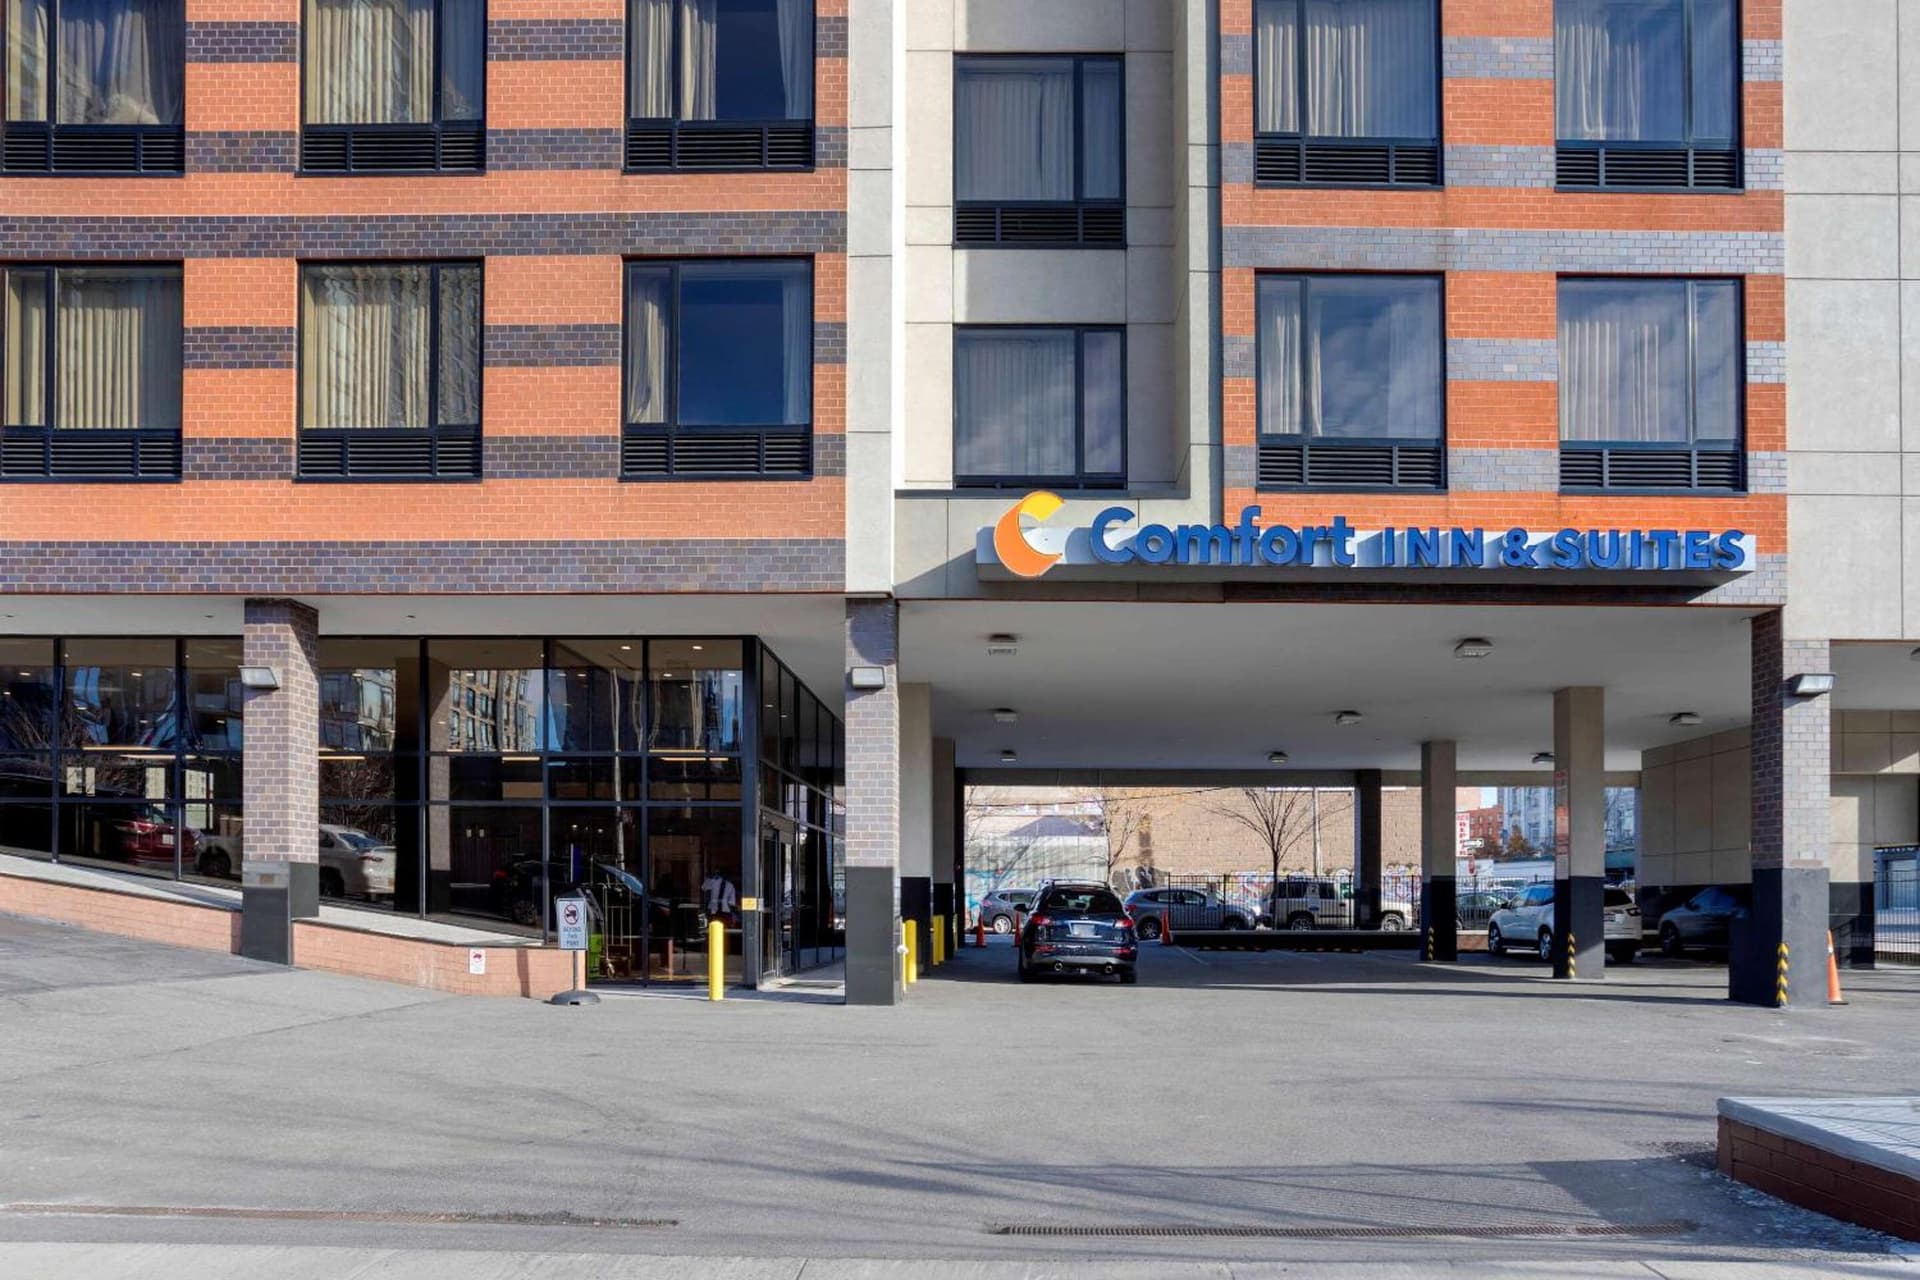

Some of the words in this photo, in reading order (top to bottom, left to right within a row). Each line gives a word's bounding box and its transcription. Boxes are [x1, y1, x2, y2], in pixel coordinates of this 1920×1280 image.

[1090, 505, 1355, 565] Comfort
[1383, 527, 1484, 567] INN
[1502, 527, 1538, 568] &
[1553, 528, 1745, 569] SUITES
